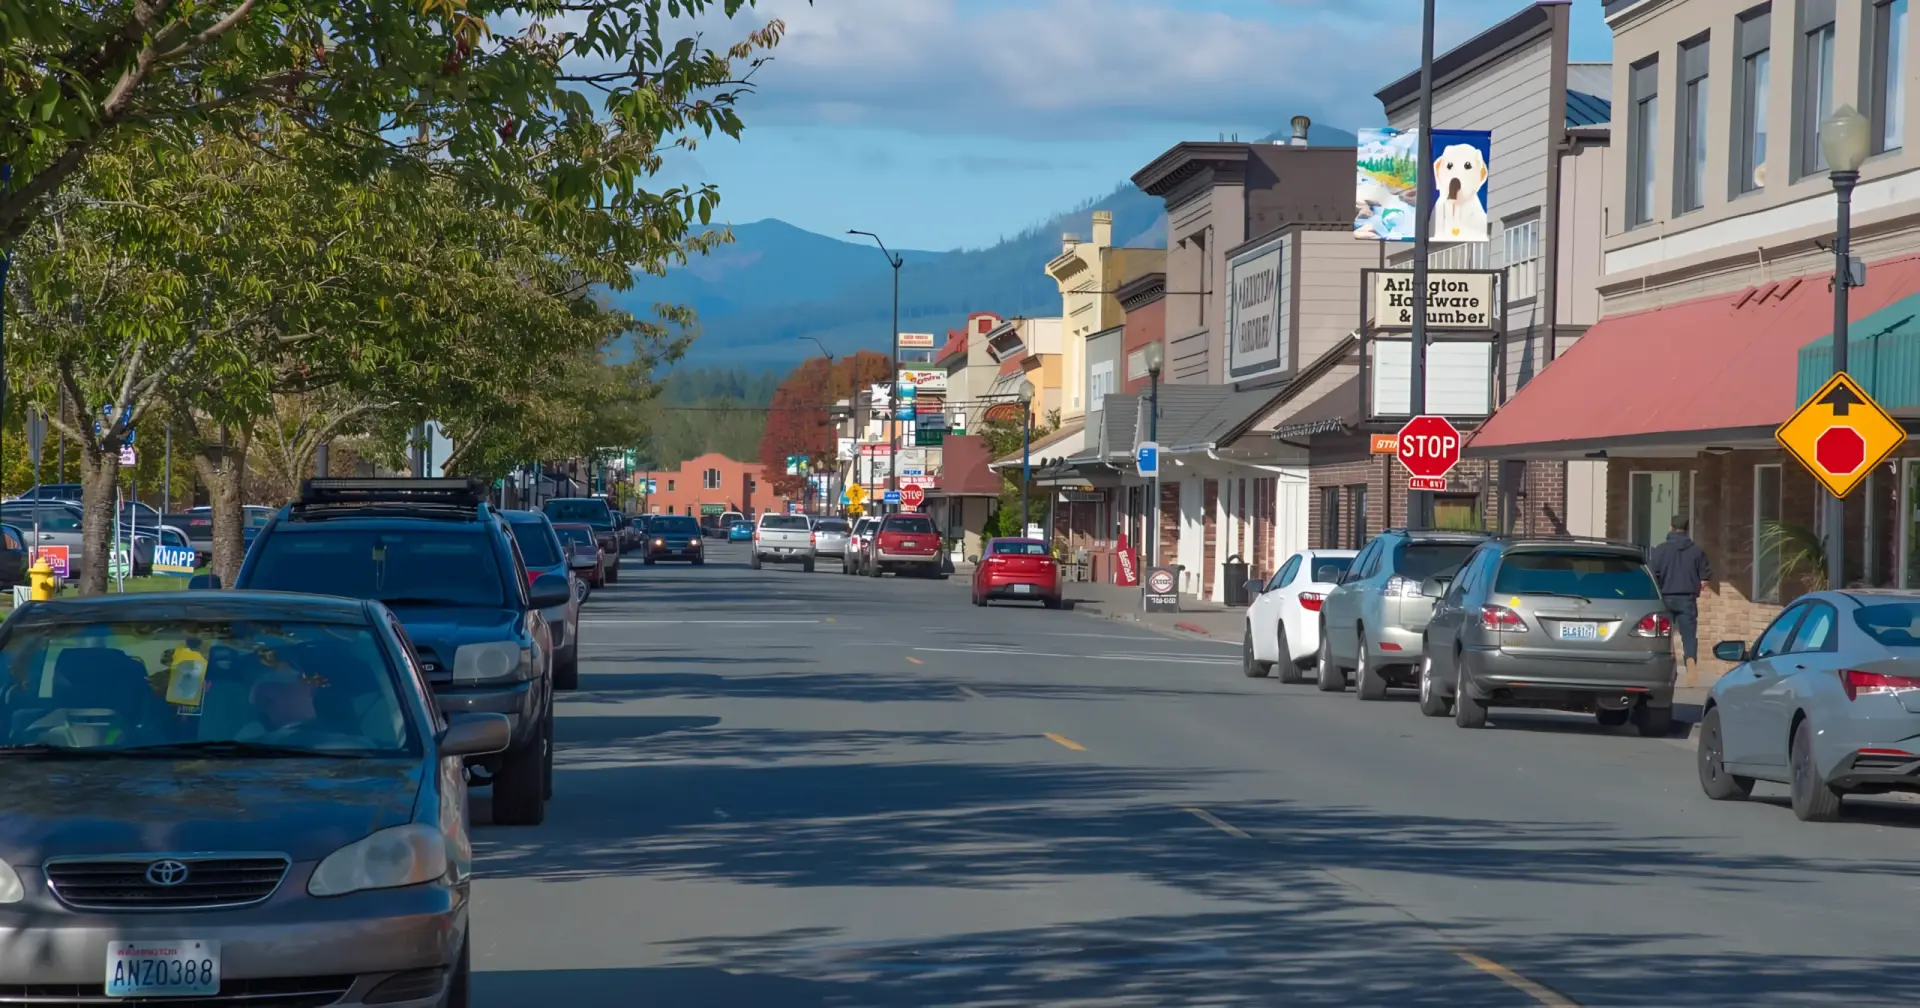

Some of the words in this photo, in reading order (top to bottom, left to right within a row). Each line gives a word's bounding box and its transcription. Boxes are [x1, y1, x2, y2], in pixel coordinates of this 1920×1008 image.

[1384, 278, 1469, 296] Arlgton
[1399, 309, 1411, 323] &
[1426, 310, 1486, 323] umber
[1402, 435, 1456, 459] STOP
[901, 490, 922, 500] STOP
[153, 546, 195, 567] KNAPP
[113, 958, 213, 987] ANZ0388
